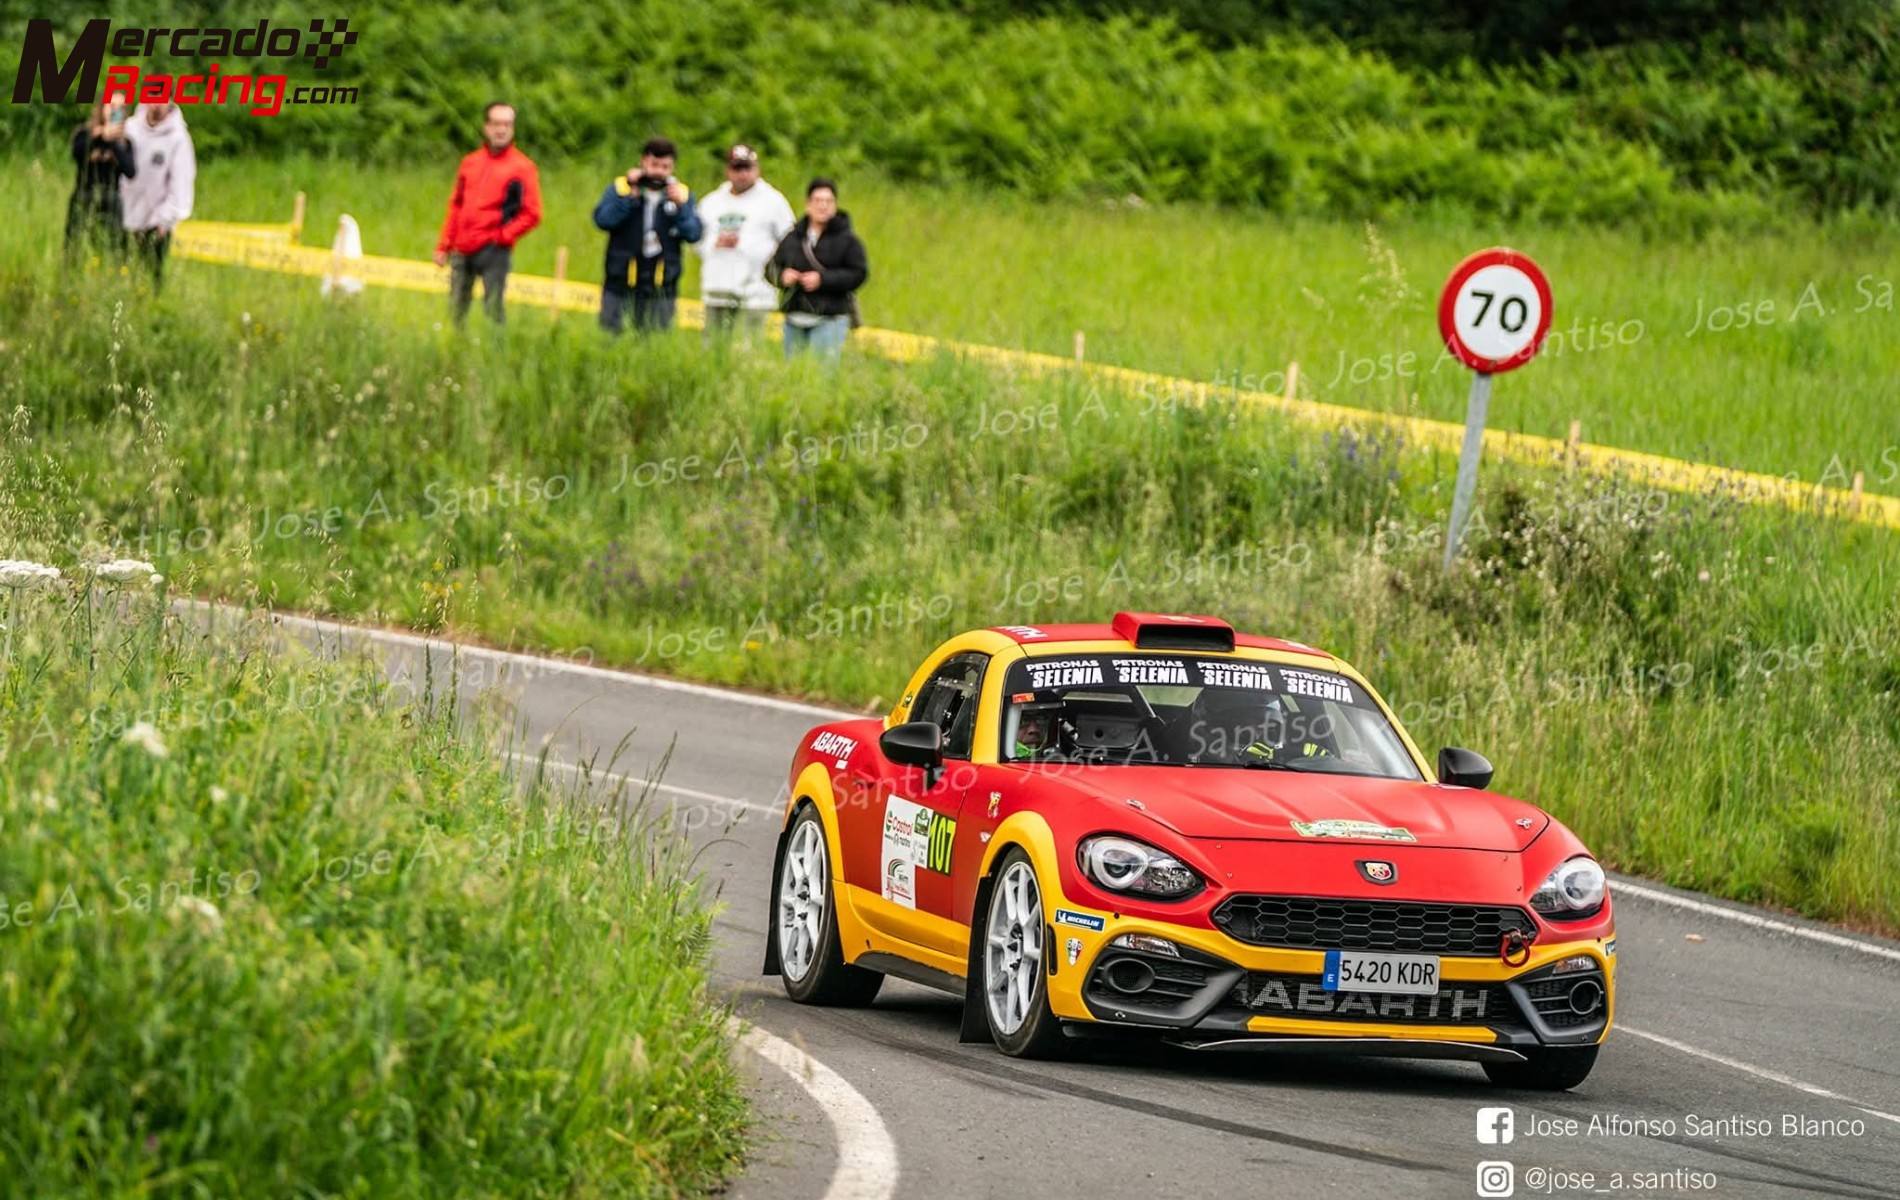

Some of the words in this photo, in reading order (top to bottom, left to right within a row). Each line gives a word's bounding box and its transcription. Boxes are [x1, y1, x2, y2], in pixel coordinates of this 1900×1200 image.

[1471, 291, 1527, 332] 70
[1026, 660, 1100, 672] PETRONAS
[1112, 659, 1184, 668] PETRONAS
[1197, 662, 1268, 674] PETRONAS
[1032, 667, 1104, 689] SELENIA
[1118, 667, 1189, 684] SELENIA
[1203, 670, 1273, 690] SELENIA
[1279, 669, 1349, 687] PETRONAS
[1286, 678, 1354, 703] SELENIA
[810, 730, 858, 760] ABARTH
[929, 814, 957, 874] 107
[1066, 915, 1101, 928] MICHELIN
[1326, 973, 1336, 983] E
[1341, 960, 1392, 983] 5420
[1397, 962, 1435, 986] KDR
[1251, 980, 1489, 1021] ABARTH
